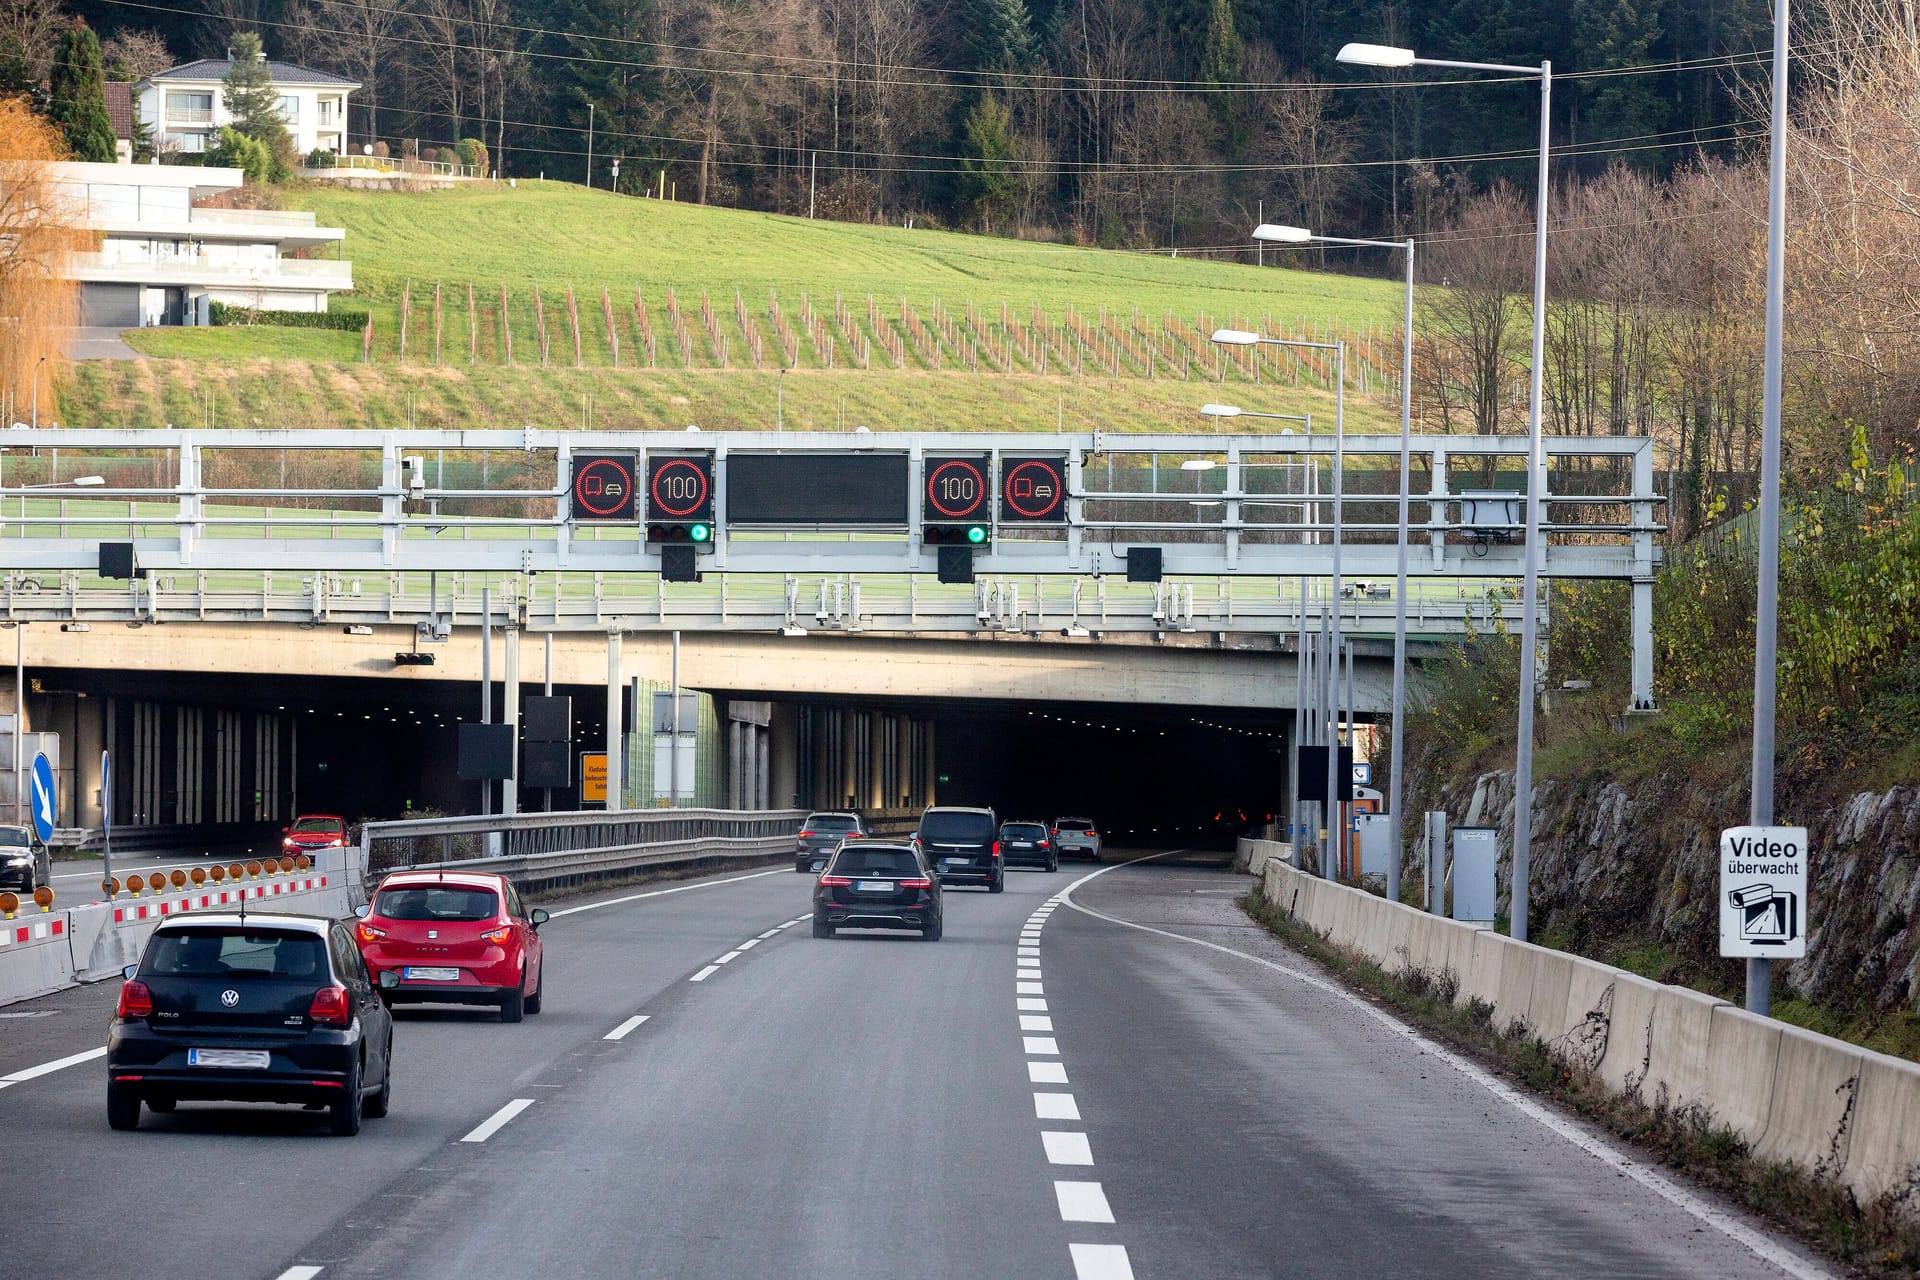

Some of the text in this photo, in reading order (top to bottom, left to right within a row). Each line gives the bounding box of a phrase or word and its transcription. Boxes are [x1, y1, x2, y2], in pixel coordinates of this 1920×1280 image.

[663, 477, 697, 499] 100
[940, 477, 974, 500] 100
[1730, 837, 1797, 858] Video
[1728, 860, 1799, 875] überwacht
